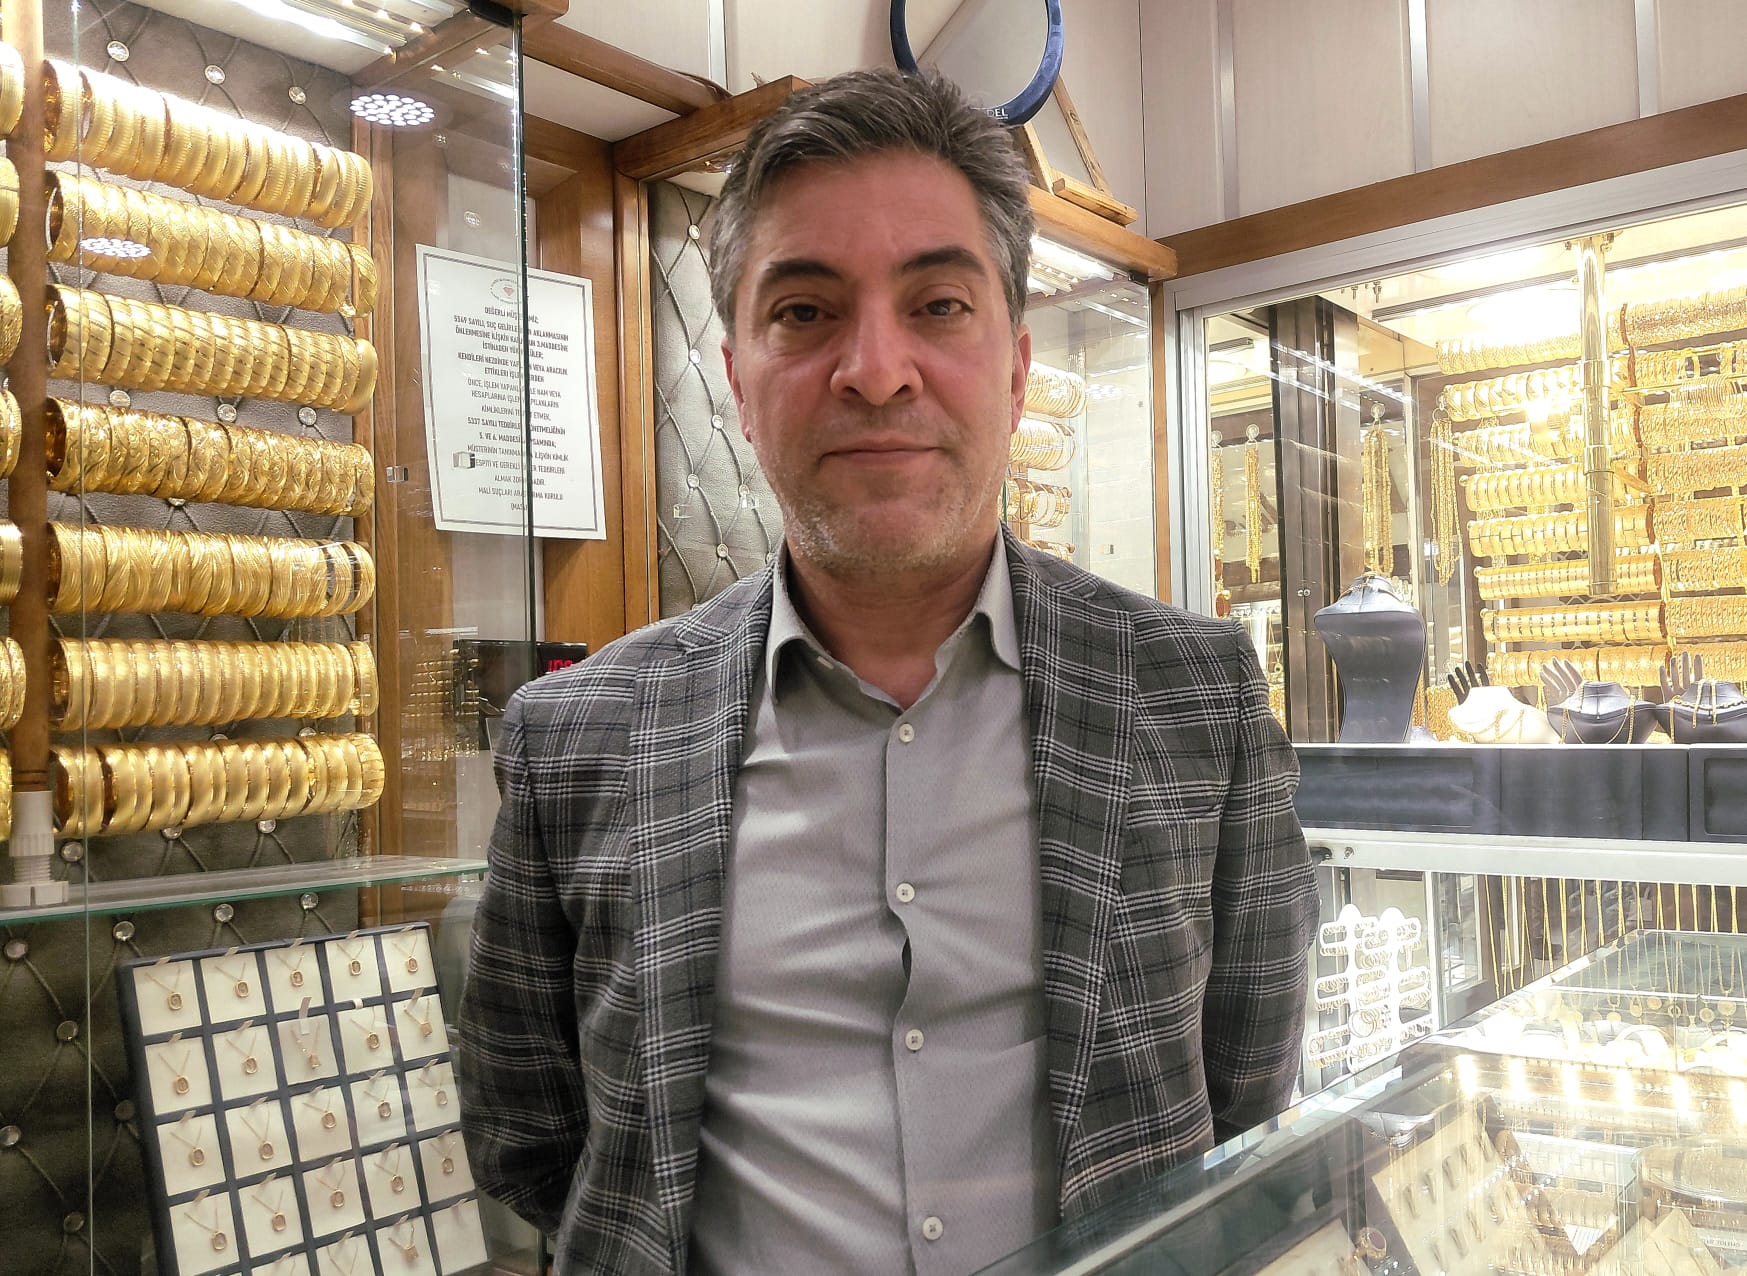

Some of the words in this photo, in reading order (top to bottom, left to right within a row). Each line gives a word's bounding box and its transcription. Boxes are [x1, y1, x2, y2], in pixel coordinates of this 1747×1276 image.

[484, 306, 506, 316] DEĞERLİ
[454, 315, 467, 323] 5549
[486, 320, 497, 330] SUÇ
